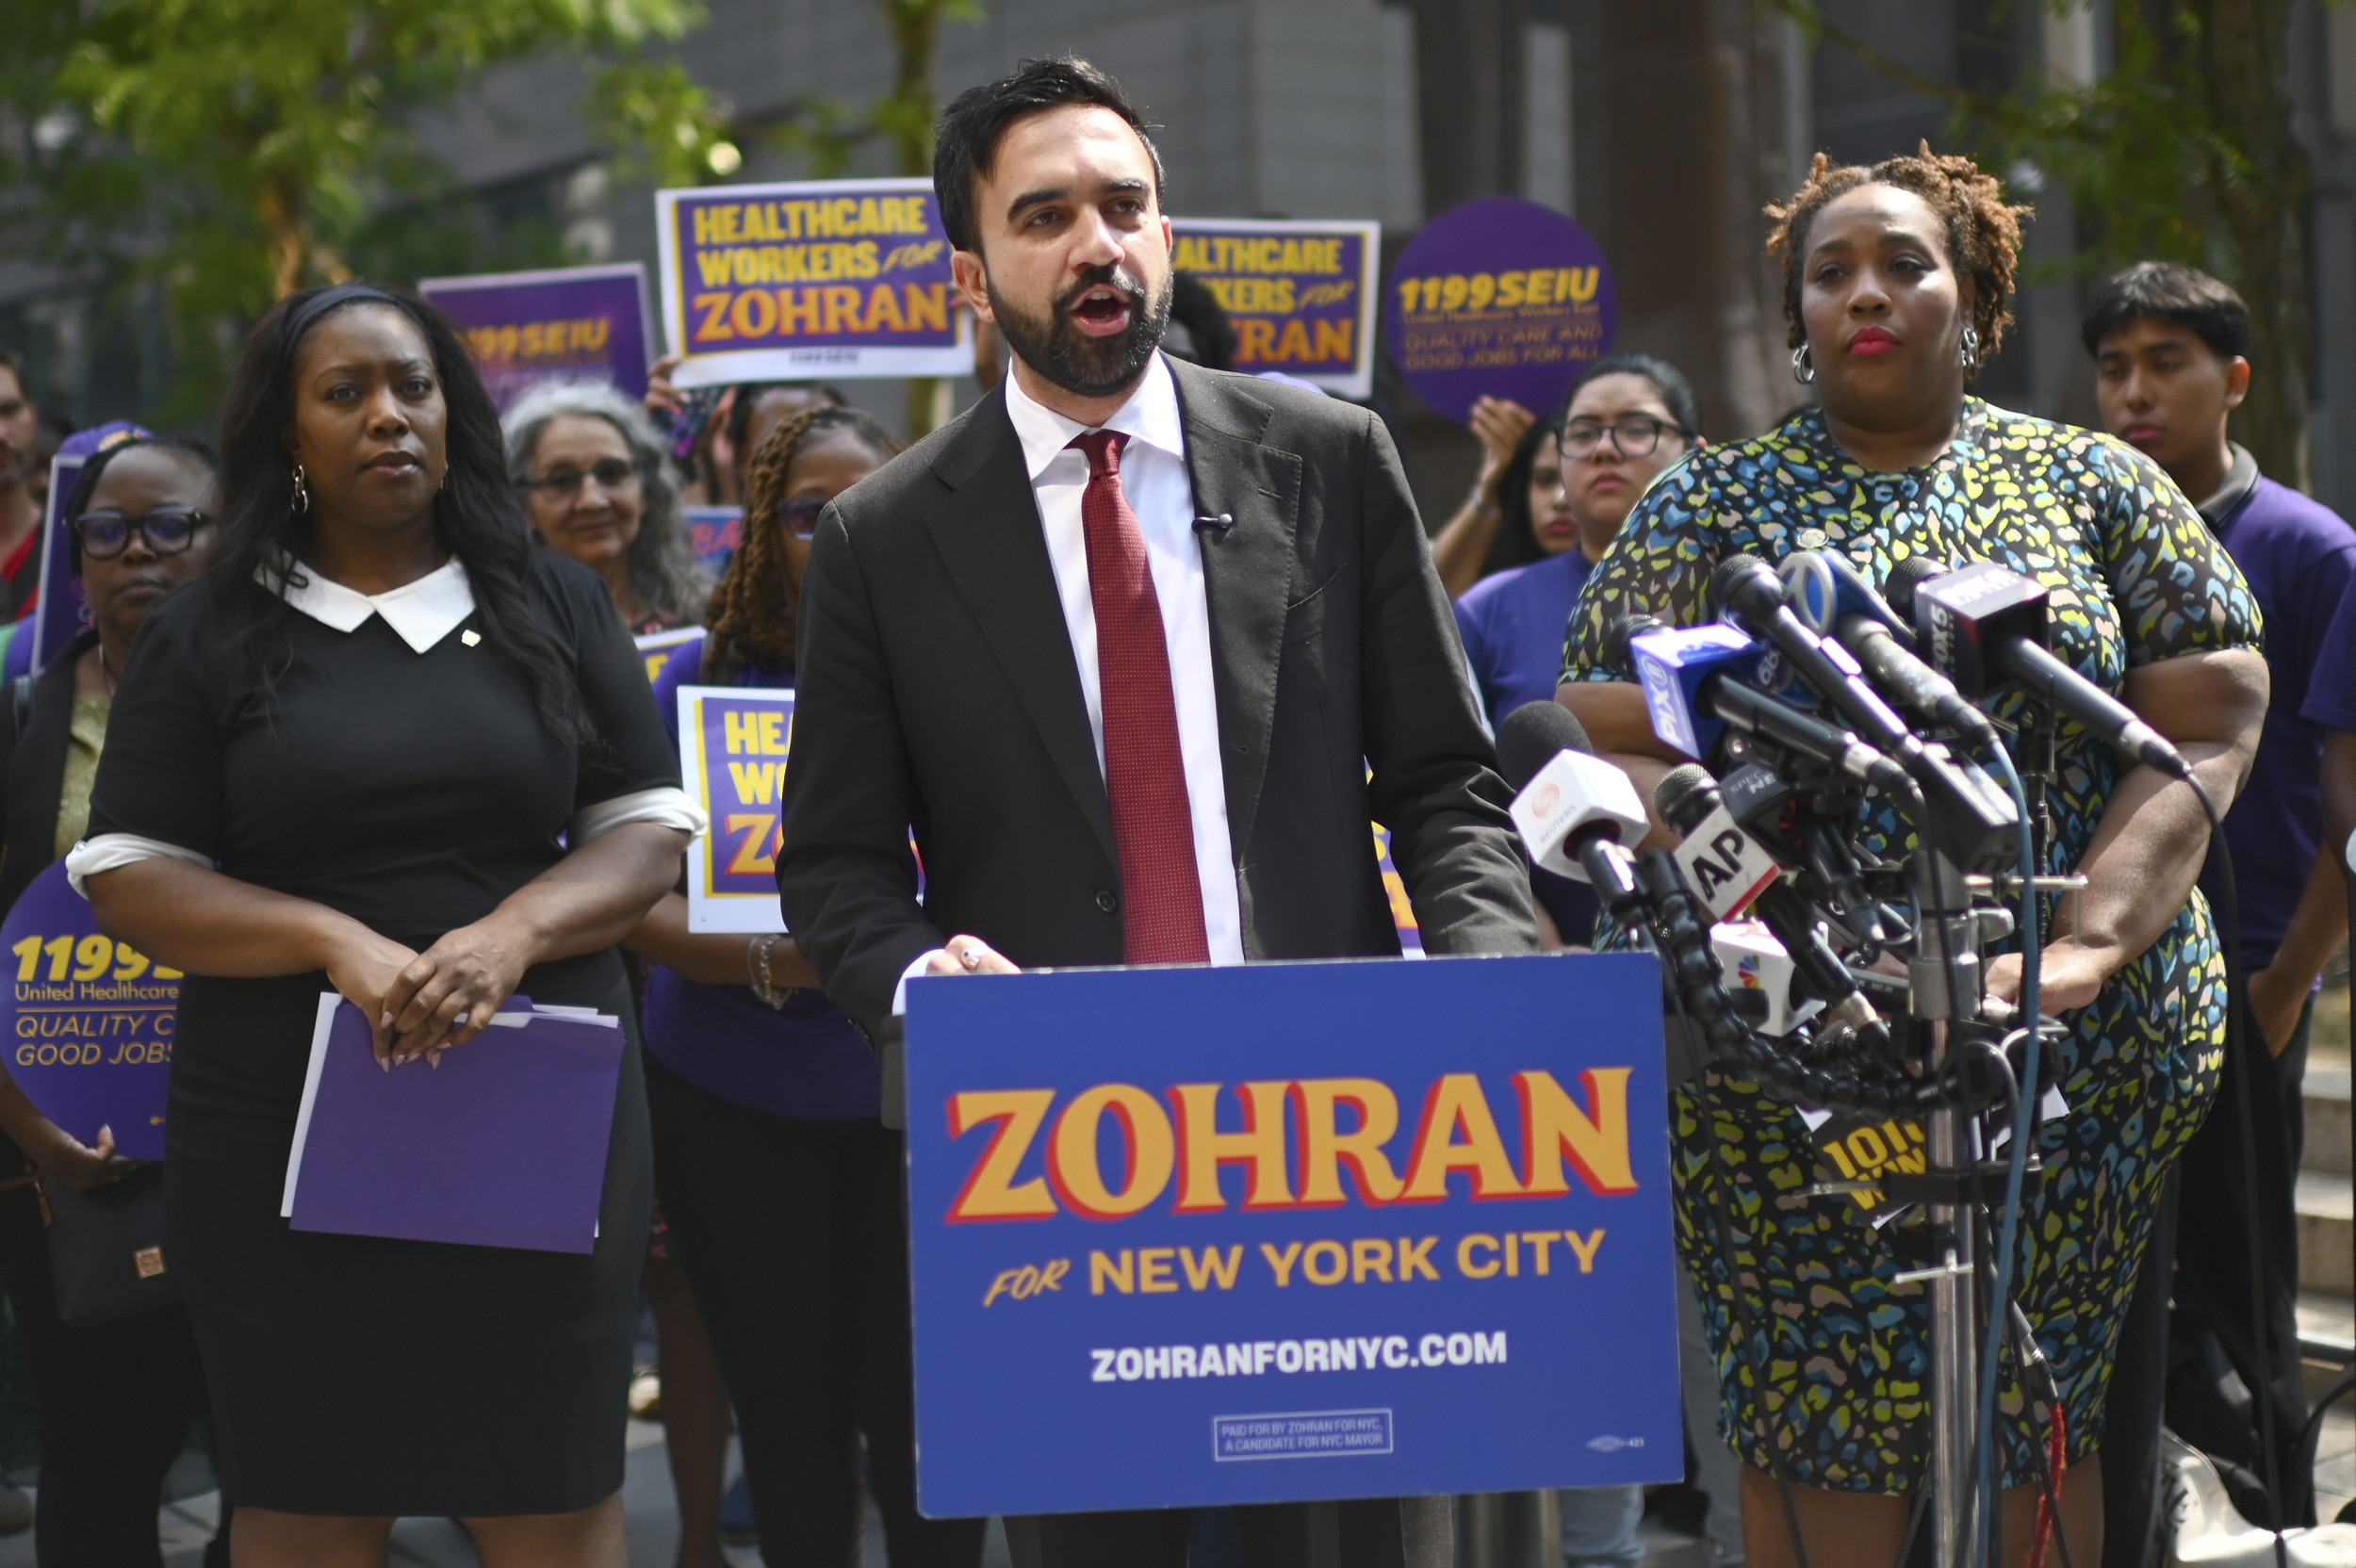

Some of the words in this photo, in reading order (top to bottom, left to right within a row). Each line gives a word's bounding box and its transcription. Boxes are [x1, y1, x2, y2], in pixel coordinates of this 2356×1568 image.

[694, 196, 928, 245] HEALTHCARE
[696, 240, 880, 287] WORKERS
[882, 239, 943, 273] FOR
[1197, 278, 1297, 313] KERS
[1400, 267, 1599, 312] 1199SEIU
[693, 283, 949, 342] ZOHRAN
[1229, 318, 1354, 364] RAN
[724, 711, 794, 755] HE
[1539, 804, 1578, 844] REUTERS
[1692, 829, 1745, 903] AP
[12, 935, 185, 981] 1199
[15, 981, 74, 1002] United
[81, 980, 179, 1001] Healthcare
[16, 1015, 147, 1037] QUALITY
[16, 1043, 102, 1066] GOOD
[945, 1067, 1640, 1224] ZOHRAN
[983, 1259, 1071, 1308] FOR
[1089, 1244, 1244, 1296] NEW
[1260, 1235, 1441, 1288] YORK
[1457, 1229, 1607, 1280] CITY
[1091, 1331, 1507, 1383] ZOHRANFORNYC.COM
[1222, 1424, 1247, 1438] PAID
[1249, 1423, 1269, 1436] FOR
[1272, 1422, 1285, 1435] BY
[1288, 1420, 1334, 1434] ZOHRAN
[1335, 1419, 1356, 1432] FOR
[1358, 1417, 1383, 1431] NYC,
[1225, 1440, 1234, 1452] A
[1235, 1437, 1296, 1452] CANDIDATE
[1298, 1435, 1319, 1448] FOR
[1321, 1434, 1344, 1447] NYC
[1346, 1432, 1383, 1446] MAYOR
